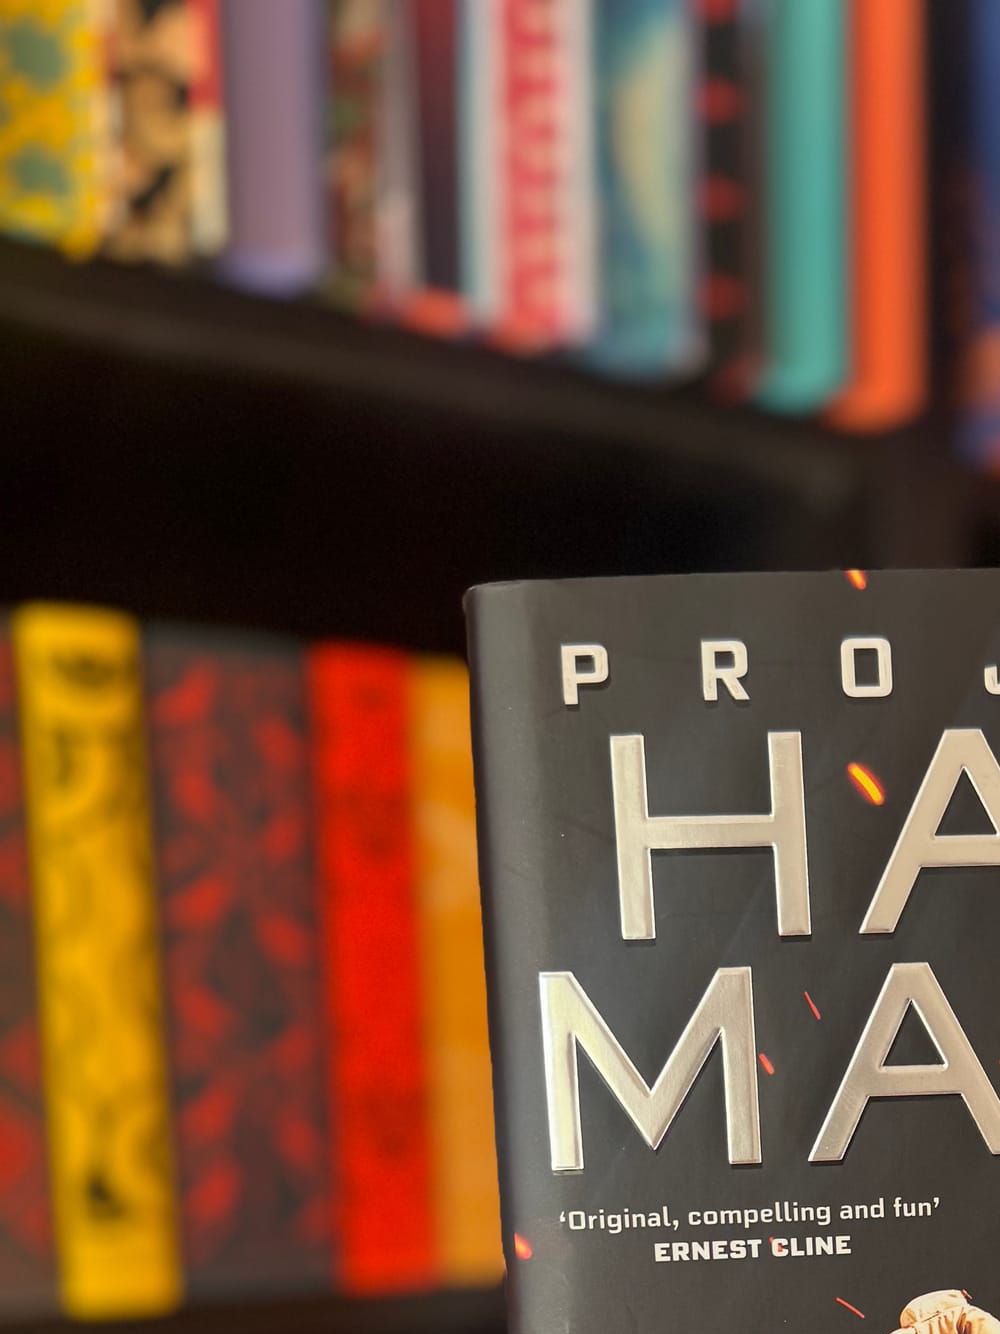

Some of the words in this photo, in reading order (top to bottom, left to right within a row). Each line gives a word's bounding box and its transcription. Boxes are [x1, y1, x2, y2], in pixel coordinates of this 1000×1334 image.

[560, 1205, 679, 1234] ‘Original,
[688, 1202, 831, 1228] compelling
[840, 1198, 885, 1220] and
[893, 1197, 940, 1218] fun’
[654, 1239, 762, 1262] ERNEST
[771, 1236, 851, 1258] CLINE
